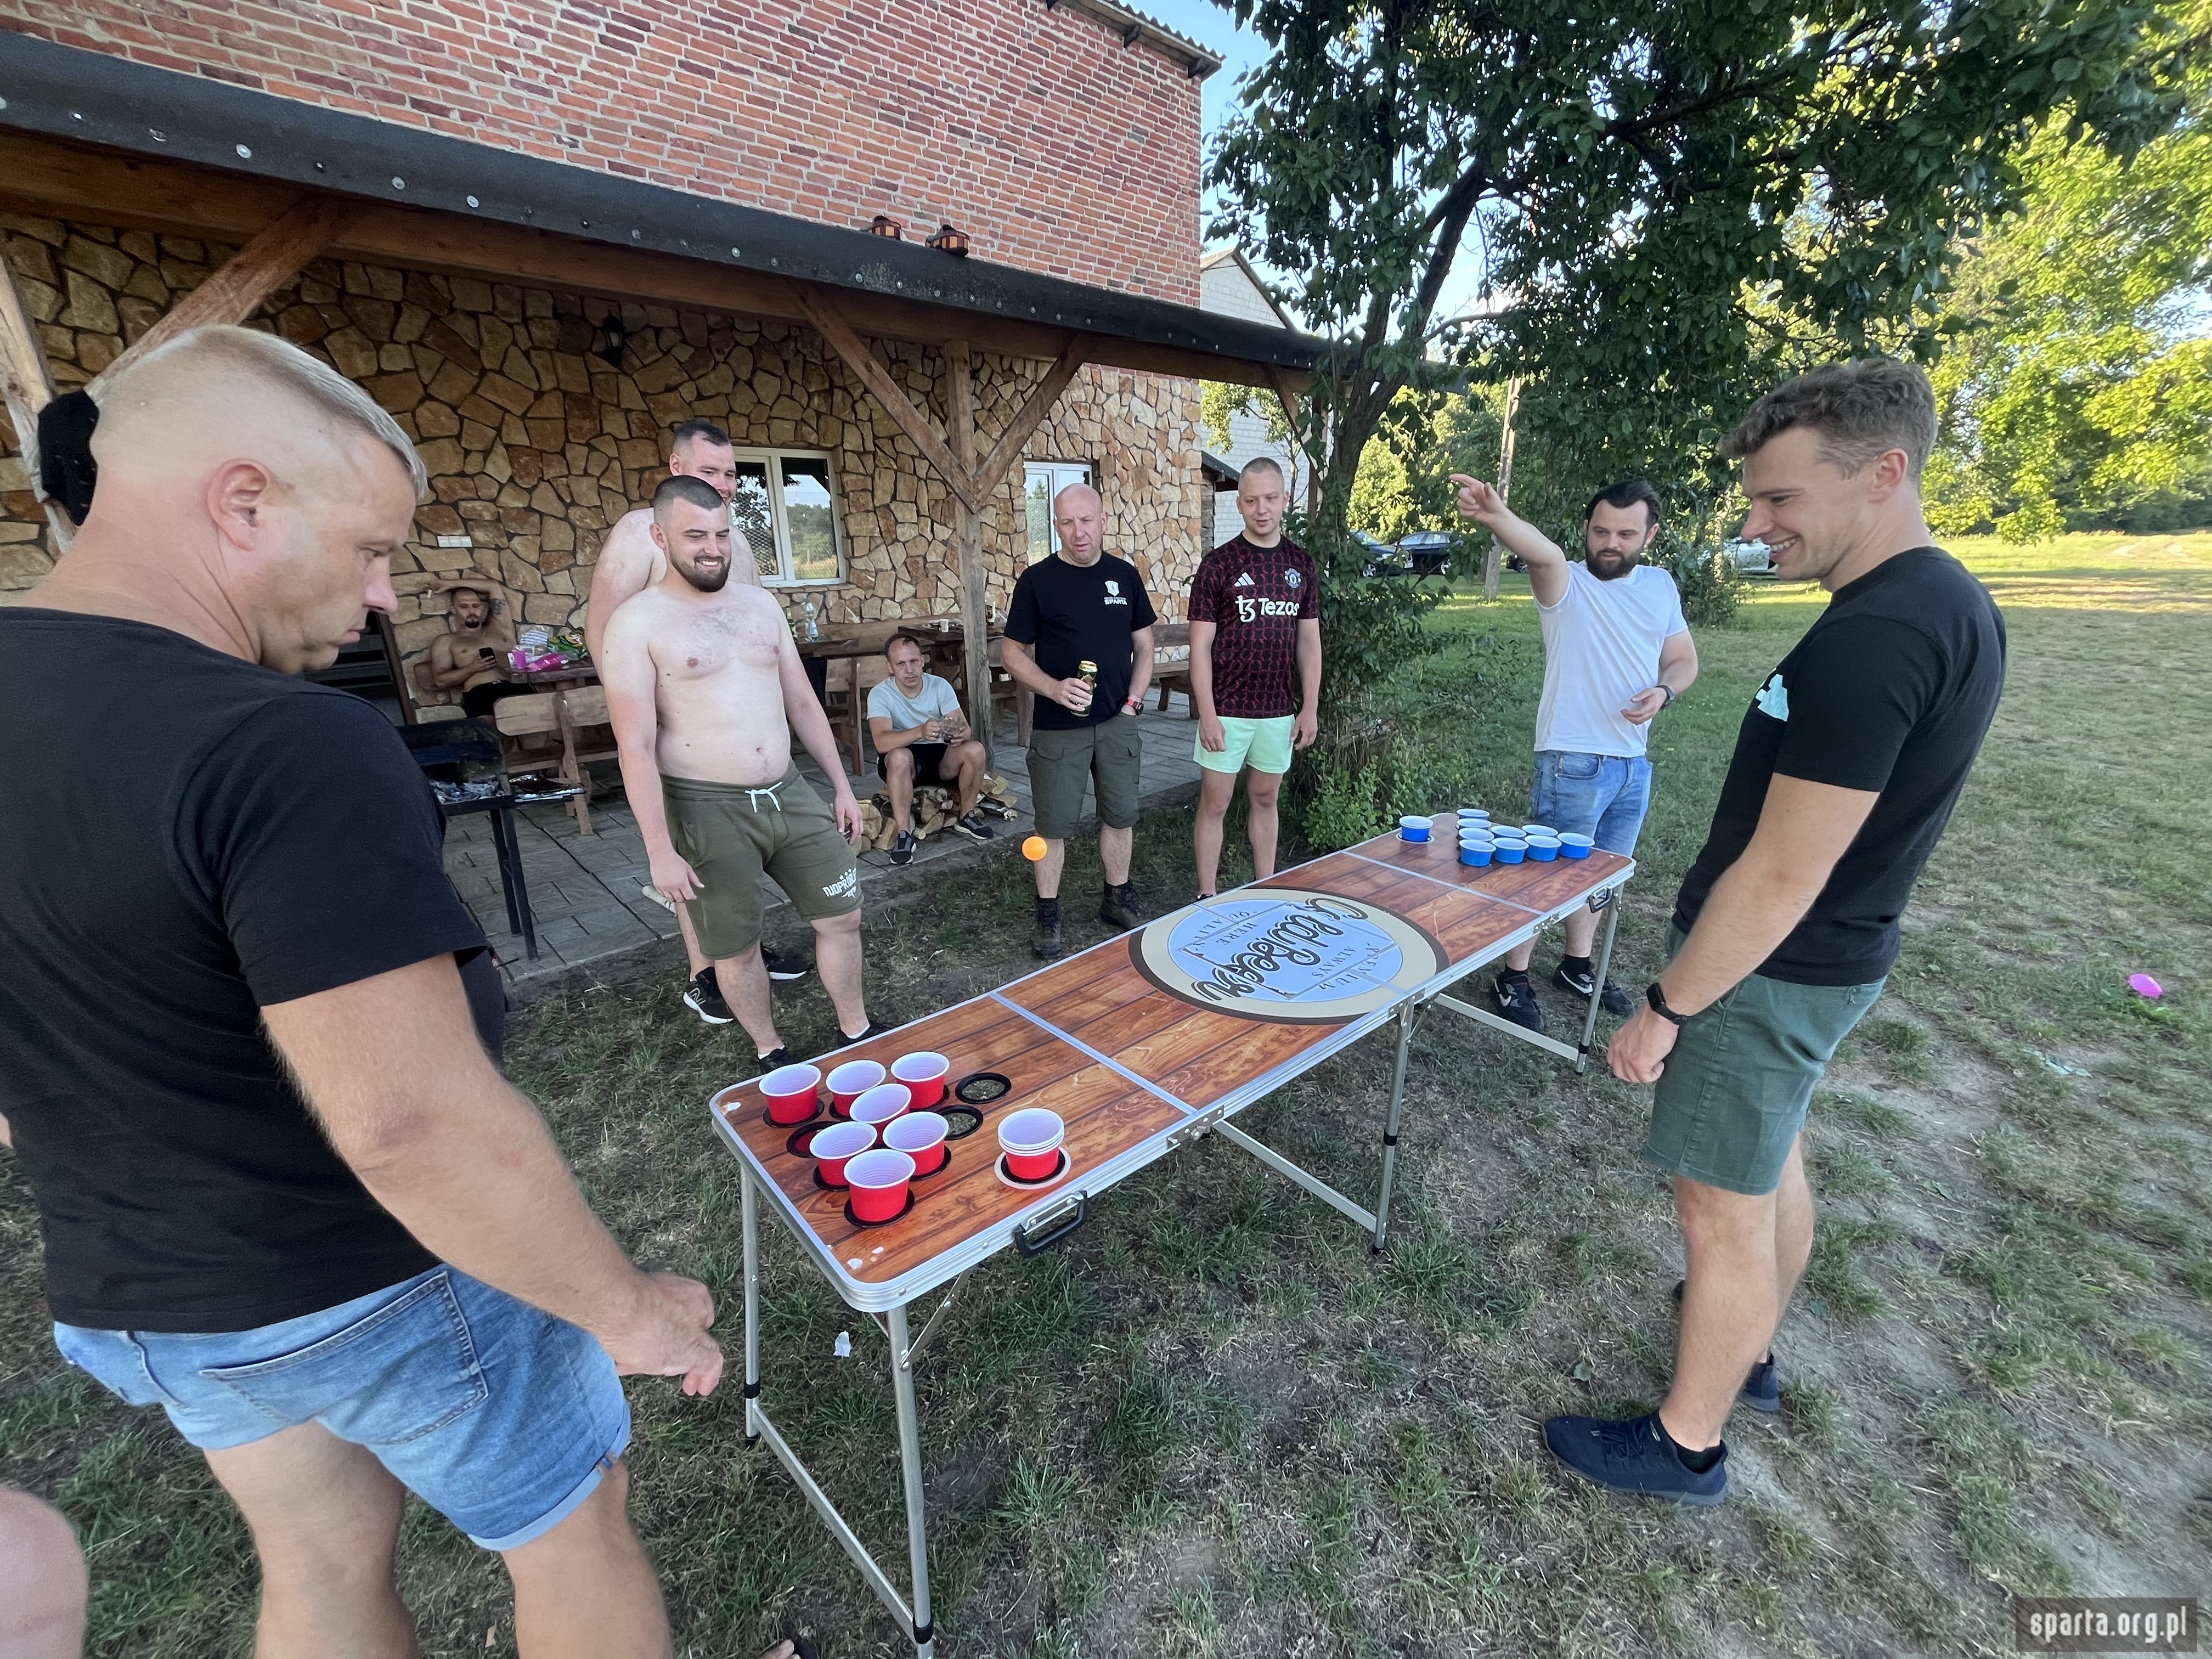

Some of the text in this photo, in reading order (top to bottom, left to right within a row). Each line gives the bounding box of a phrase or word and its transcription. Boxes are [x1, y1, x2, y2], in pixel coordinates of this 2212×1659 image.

[1258, 597, 1300, 616] Tezos
[1216, 922, 1257, 945] HERE
[1312, 946, 1356, 978] ALWAYS
